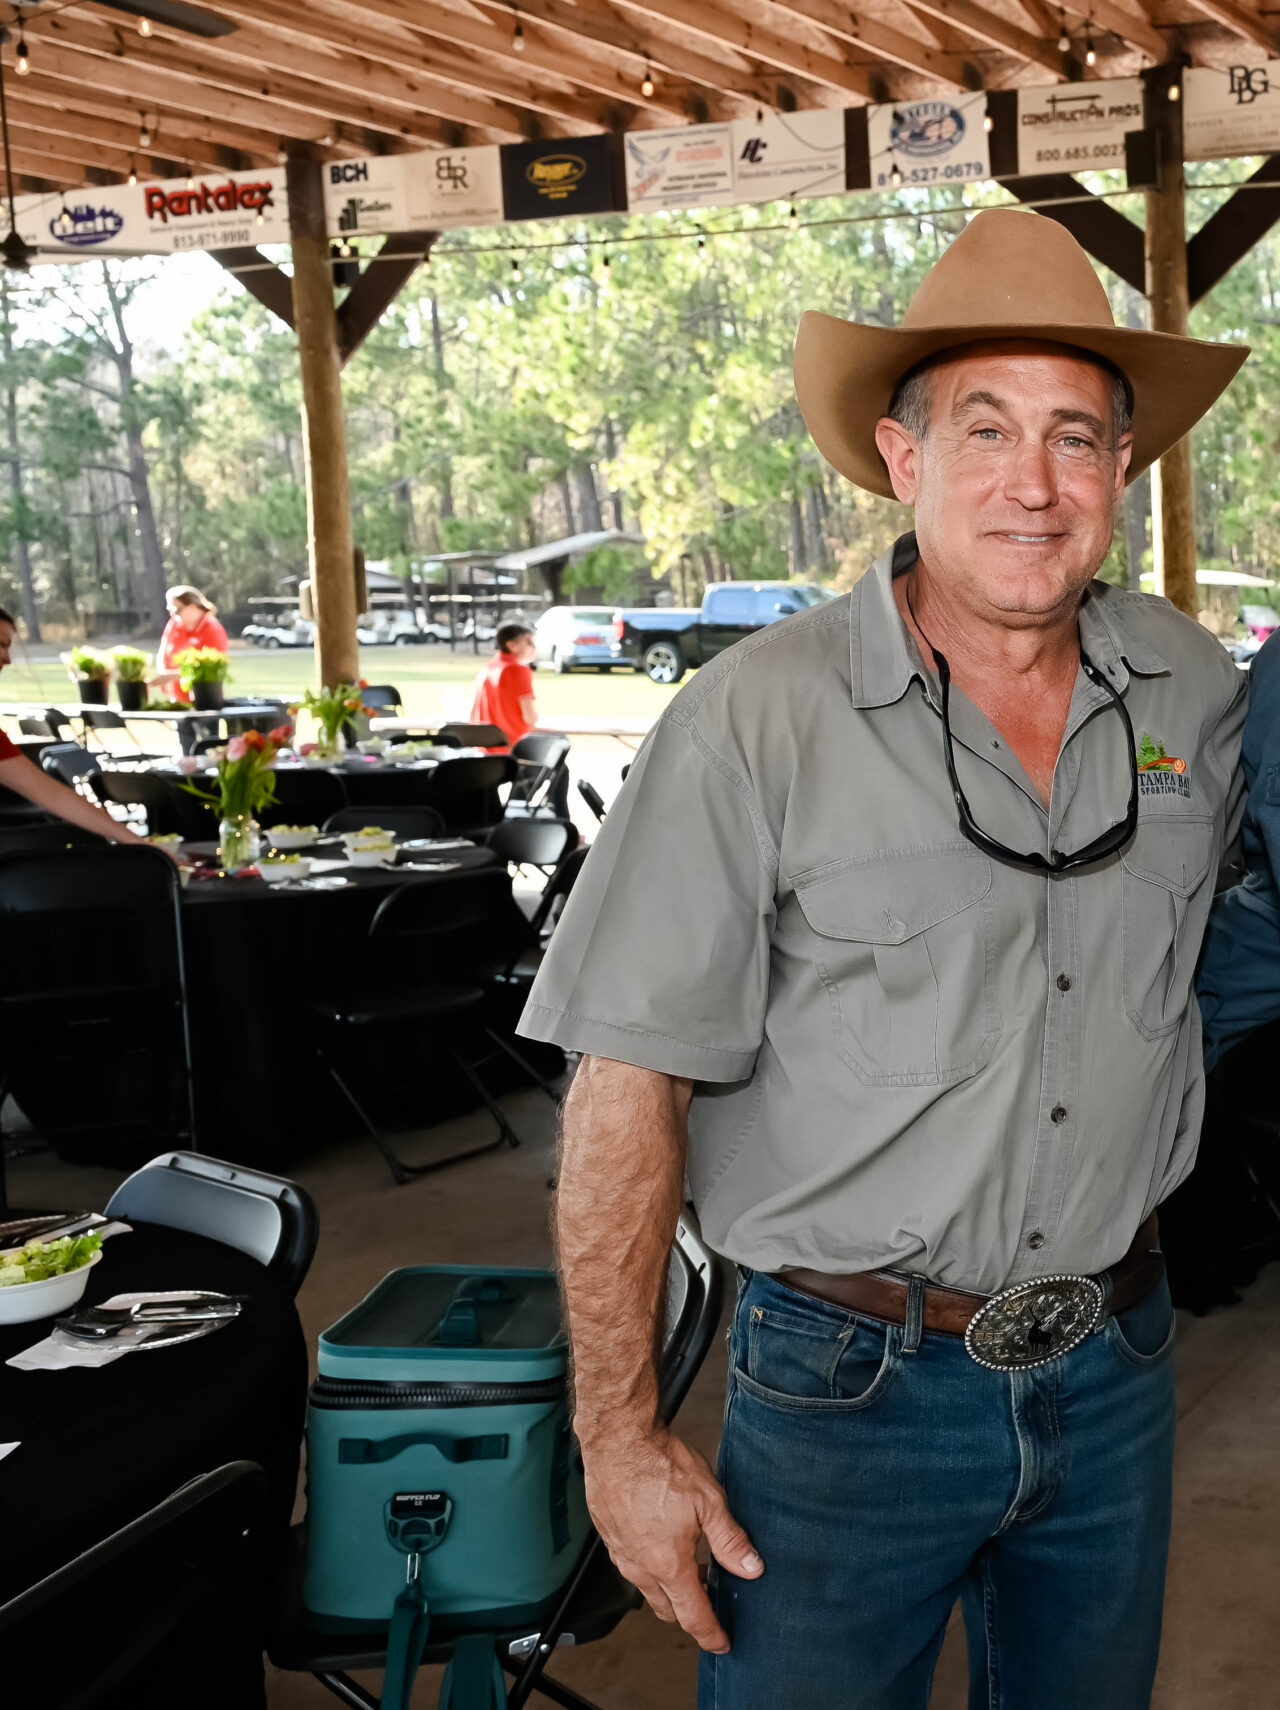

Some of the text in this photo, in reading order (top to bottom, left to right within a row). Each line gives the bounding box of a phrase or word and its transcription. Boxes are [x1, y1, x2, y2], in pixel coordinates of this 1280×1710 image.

[1108, 103, 1142, 117] PROS
[1035, 142, 1126, 163] 800.685.002
[329, 161, 369, 185] BCH
[877, 160, 984, 187] 83-527-0679
[143, 178, 275, 224] Rentalex
[1138, 770, 1191, 791] TAMPA BAY
[1140, 785, 1177, 796] SPORTING
[396, 1494, 425, 1502] HOPPER
